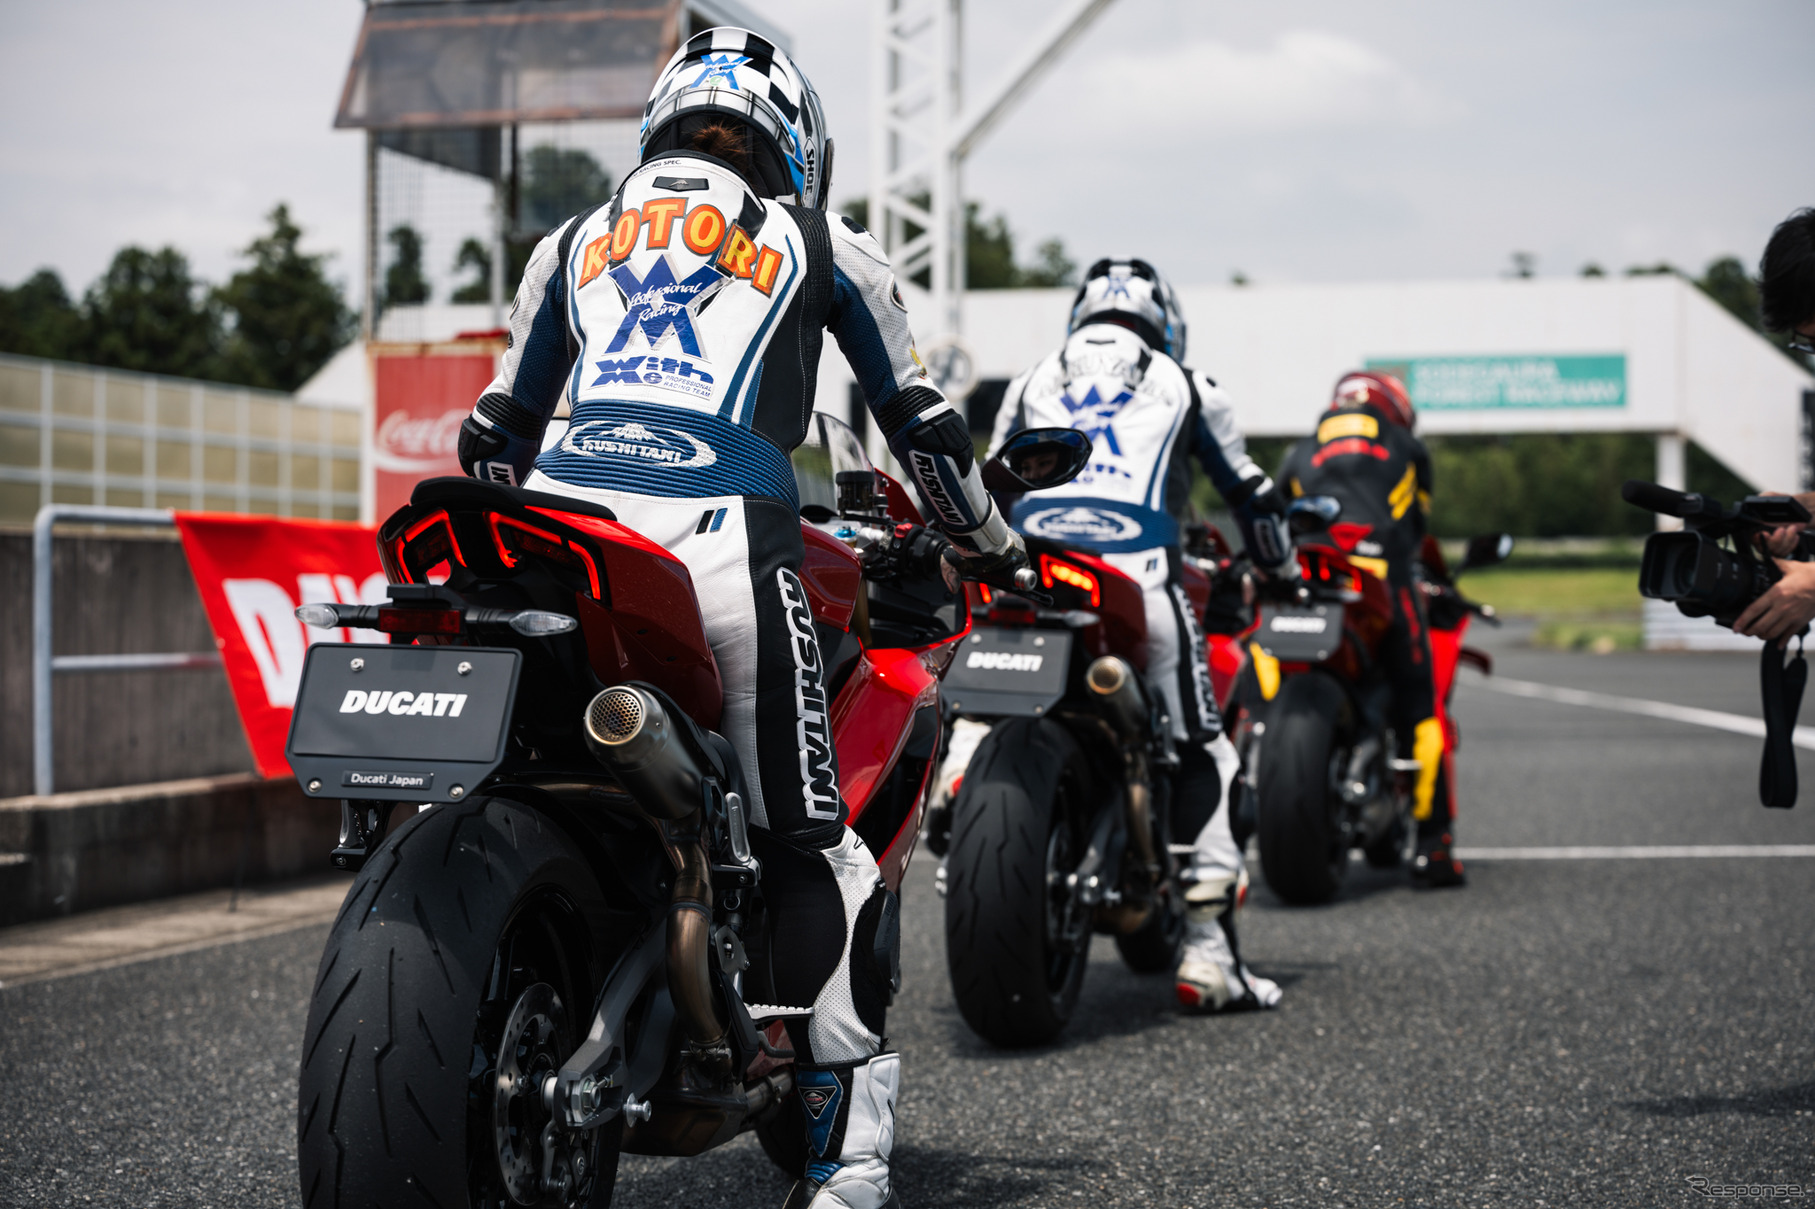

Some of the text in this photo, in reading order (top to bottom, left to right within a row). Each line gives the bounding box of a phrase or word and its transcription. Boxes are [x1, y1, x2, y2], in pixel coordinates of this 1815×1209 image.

[640, 162, 662, 173] RACING
[577, 197, 784, 299] KOTORI
[630, 282, 703, 305] Professional
[638, 302, 684, 322] Racing
[663, 381, 711, 398] RACING TEAM
[665, 374, 712, 392] PROFESSIONAL
[966, 651, 1043, 672] DUCATI
[339, 689, 468, 718] DUCATI
[350, 772, 424, 787] Ducati Japan
